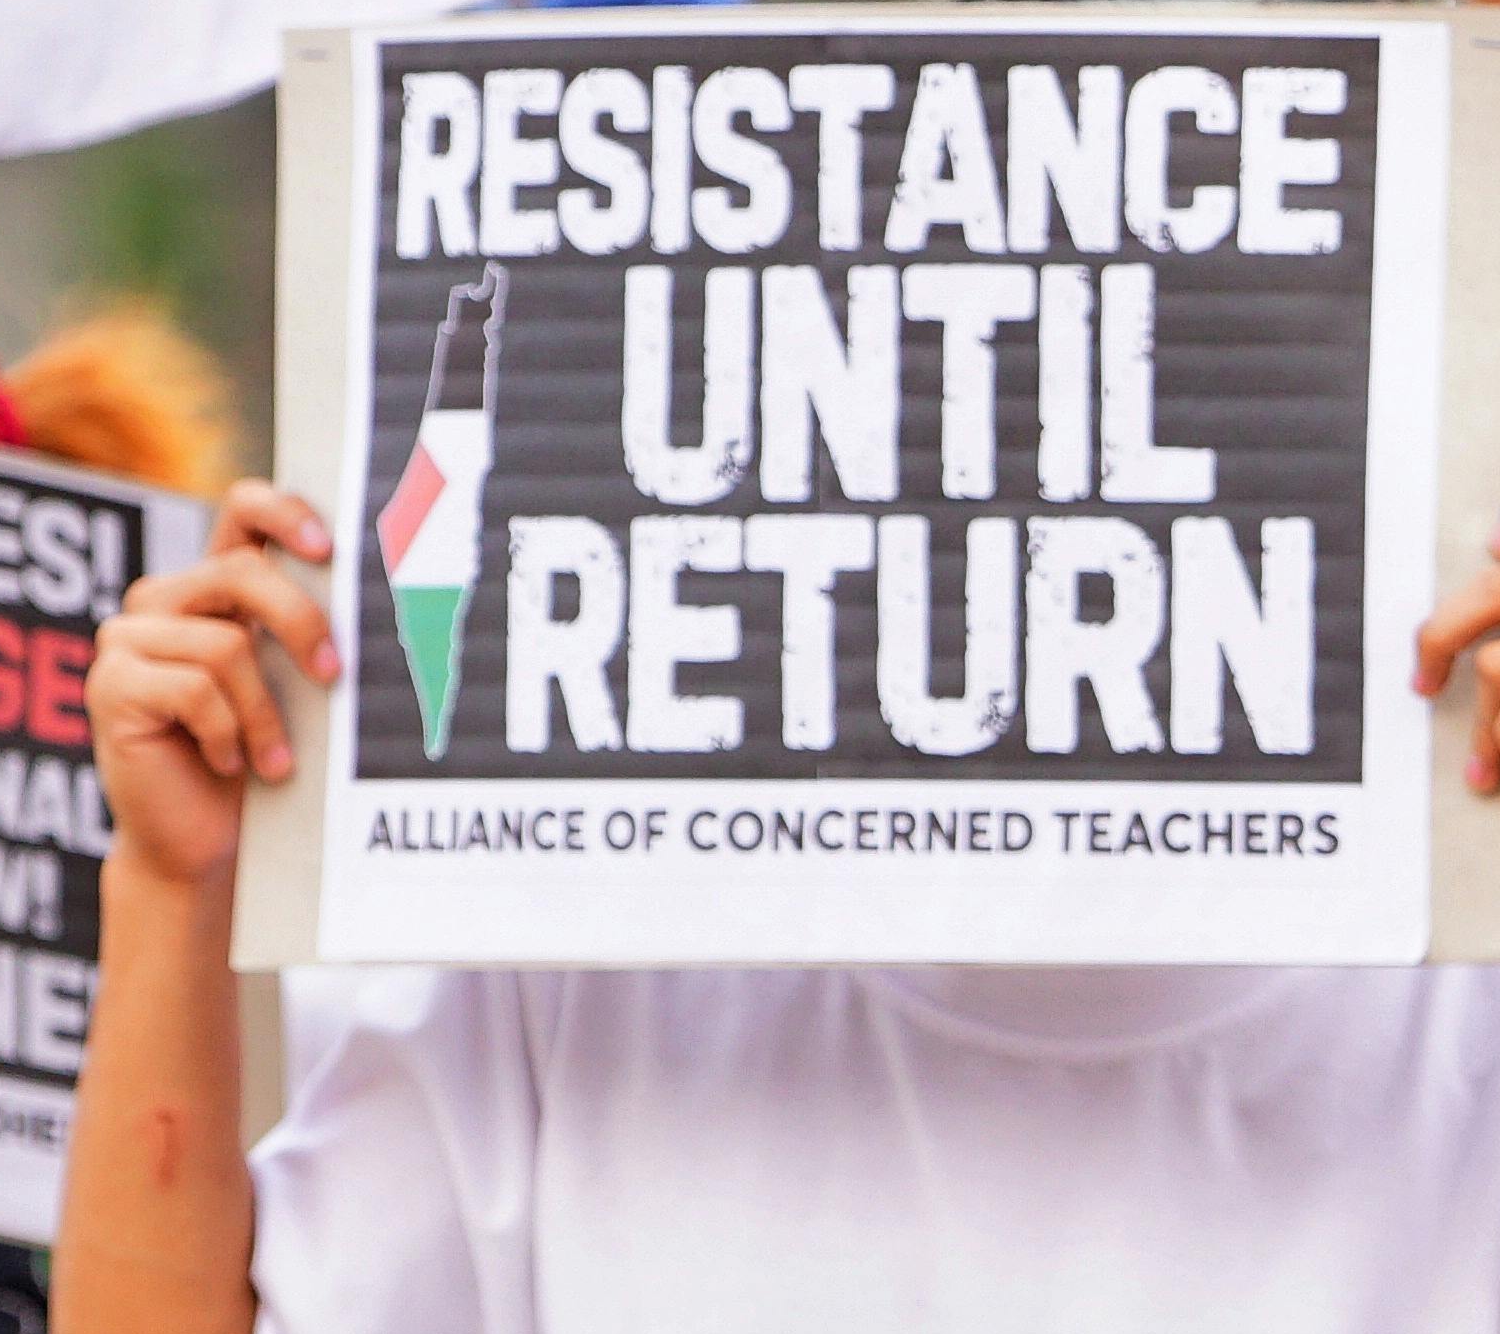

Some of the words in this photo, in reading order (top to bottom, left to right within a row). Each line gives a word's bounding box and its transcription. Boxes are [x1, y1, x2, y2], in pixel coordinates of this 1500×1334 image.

[395, 62, 1347, 260] RESISTANCE
[621, 262, 1217, 505] UNTIL
[506, 514, 1316, 757] RETURN
[367, 809, 585, 853] ALLIANCE
[605, 810, 667, 852] OF
[687, 810, 1034, 855] CONCERNED
[1055, 812, 1340, 857] TEACHERS
